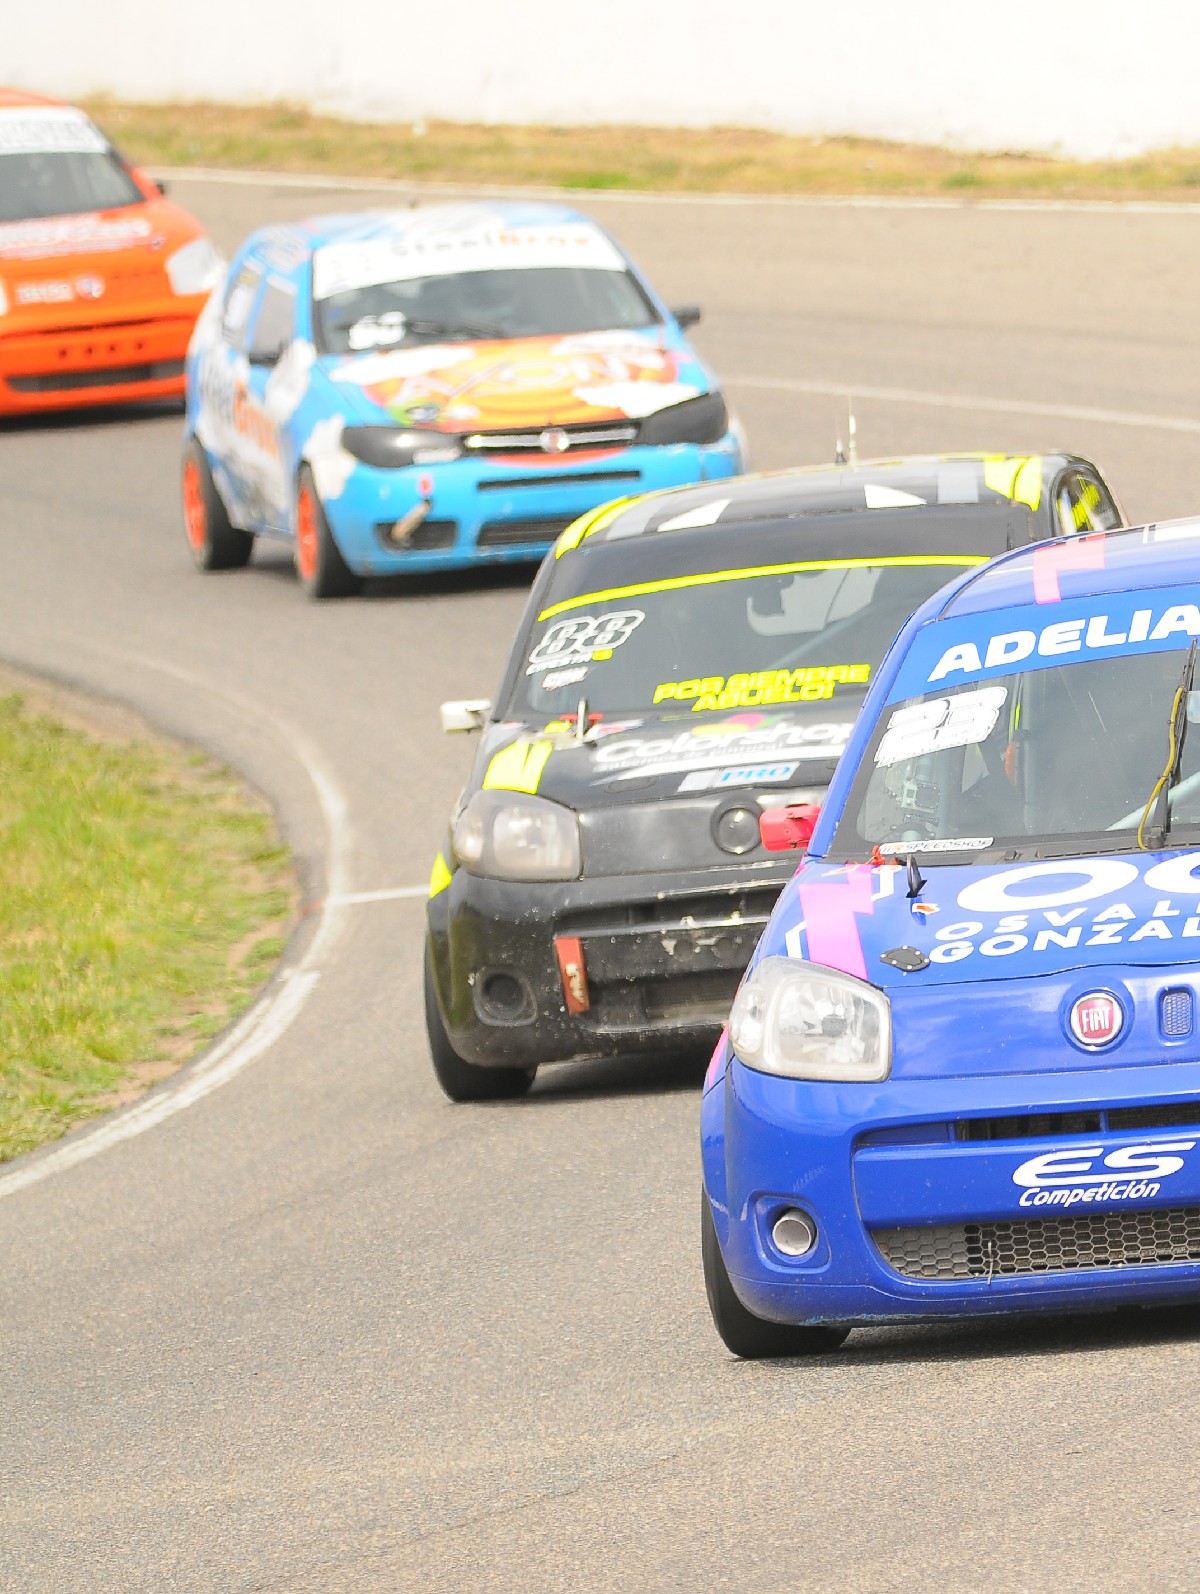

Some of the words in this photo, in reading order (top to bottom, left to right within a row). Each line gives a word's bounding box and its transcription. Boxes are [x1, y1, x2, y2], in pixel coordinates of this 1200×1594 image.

[528, 609, 646, 664] 88
[653, 676, 725, 704] POR
[724, 664, 871, 694] SIEMPRE
[874, 686, 1008, 762] 23
[722, 766, 791, 783] PRO
[1081, 1005, 1111, 1034] FIAT
[1012, 1141, 1197, 1187] ES
[1019, 1180, 1161, 1208] Competición
